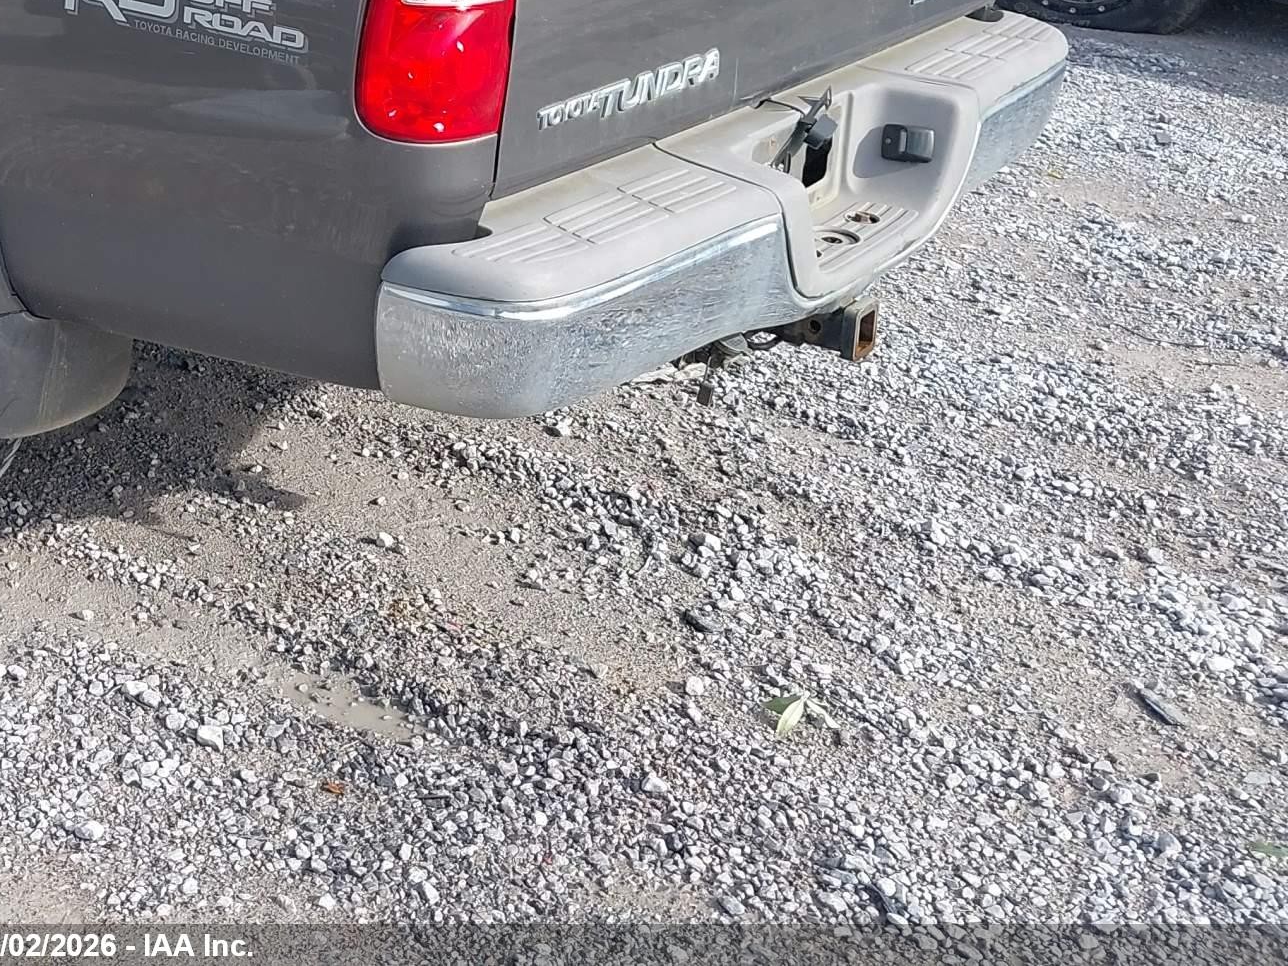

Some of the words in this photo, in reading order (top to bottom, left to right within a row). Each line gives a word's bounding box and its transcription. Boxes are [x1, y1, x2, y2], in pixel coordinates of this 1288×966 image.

[133, 19, 173, 36] TOYOTA
[174, 28, 216, 46] RACING
[217, 37, 301, 66] DEVELOPMENT
[183, 6, 309, 54] ROAD
[536, 93, 602, 131] TOYOTA
[597, 47, 720, 119] TUNDRA
